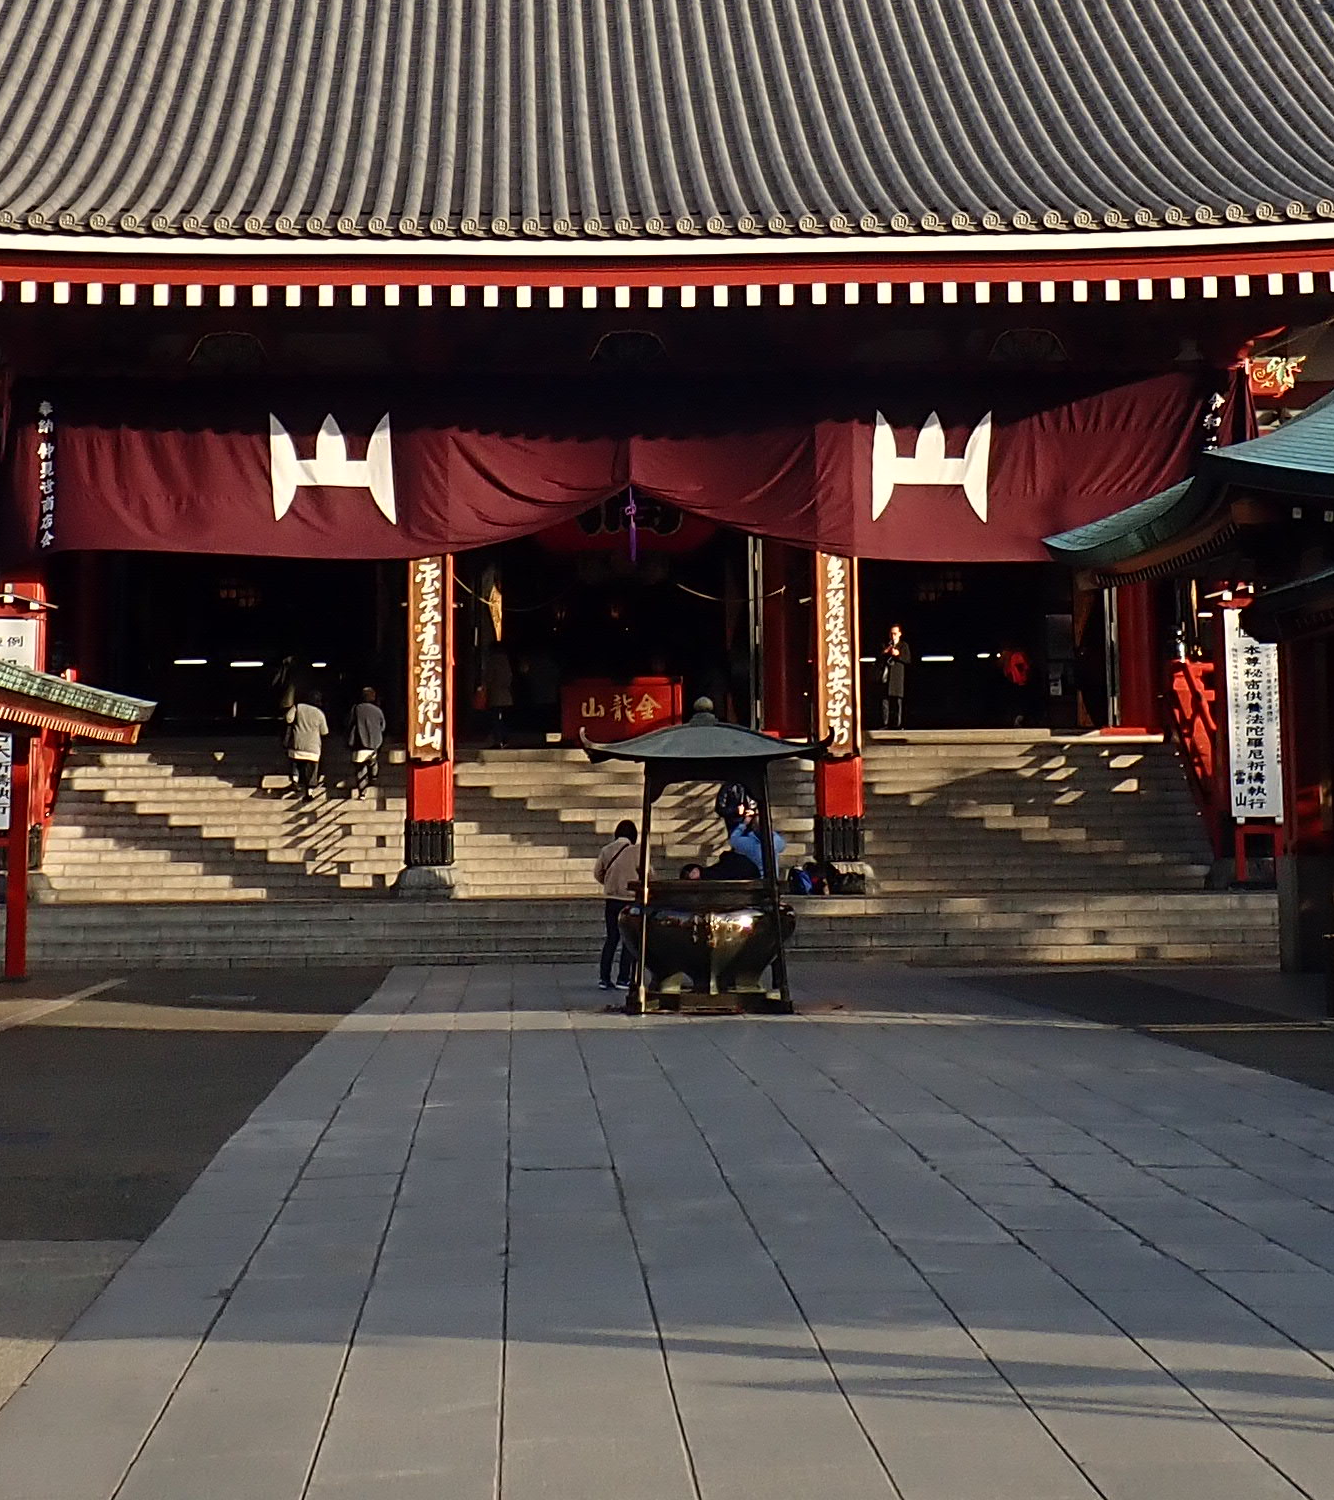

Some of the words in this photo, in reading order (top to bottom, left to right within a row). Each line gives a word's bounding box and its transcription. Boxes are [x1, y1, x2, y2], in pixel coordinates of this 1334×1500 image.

[37, 400, 54, 435] 奉納
[37, 442, 55, 549] 仲見世商店会
